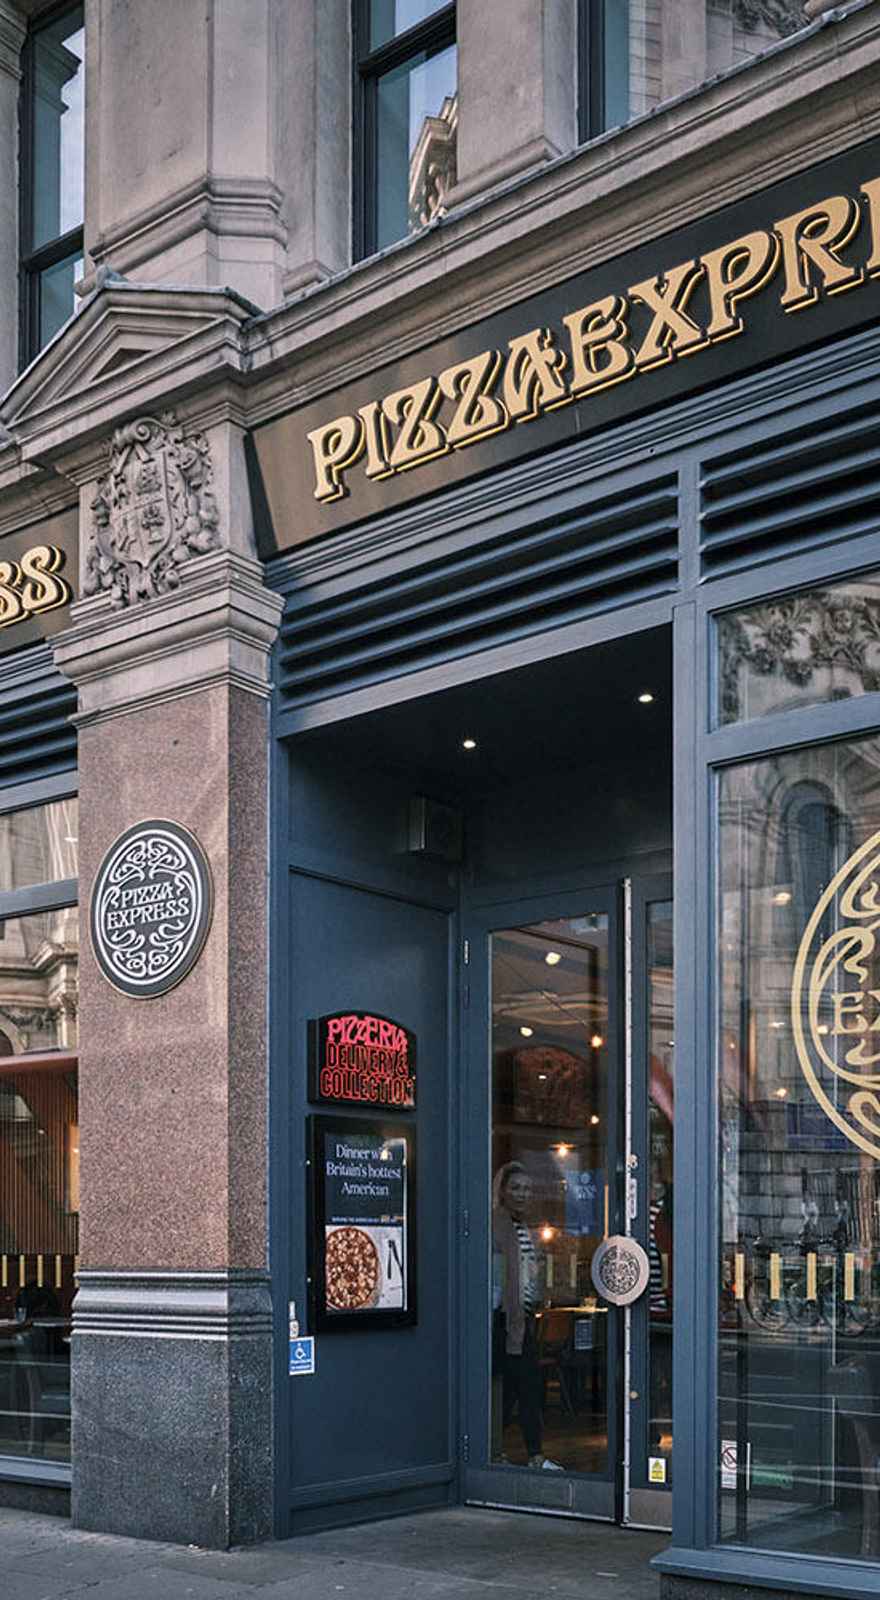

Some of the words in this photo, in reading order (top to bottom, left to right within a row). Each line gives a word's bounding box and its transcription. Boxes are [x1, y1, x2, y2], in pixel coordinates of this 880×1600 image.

[121, 882, 174, 908] PIZZA
[107, 898, 189, 930] EXPRESS
[336, 1144, 370, 1160] Dinner
[326, 1161, 367, 1177] Britain's
[367, 1163, 401, 1178] hottest
[341, 1182, 389, 1196] American
